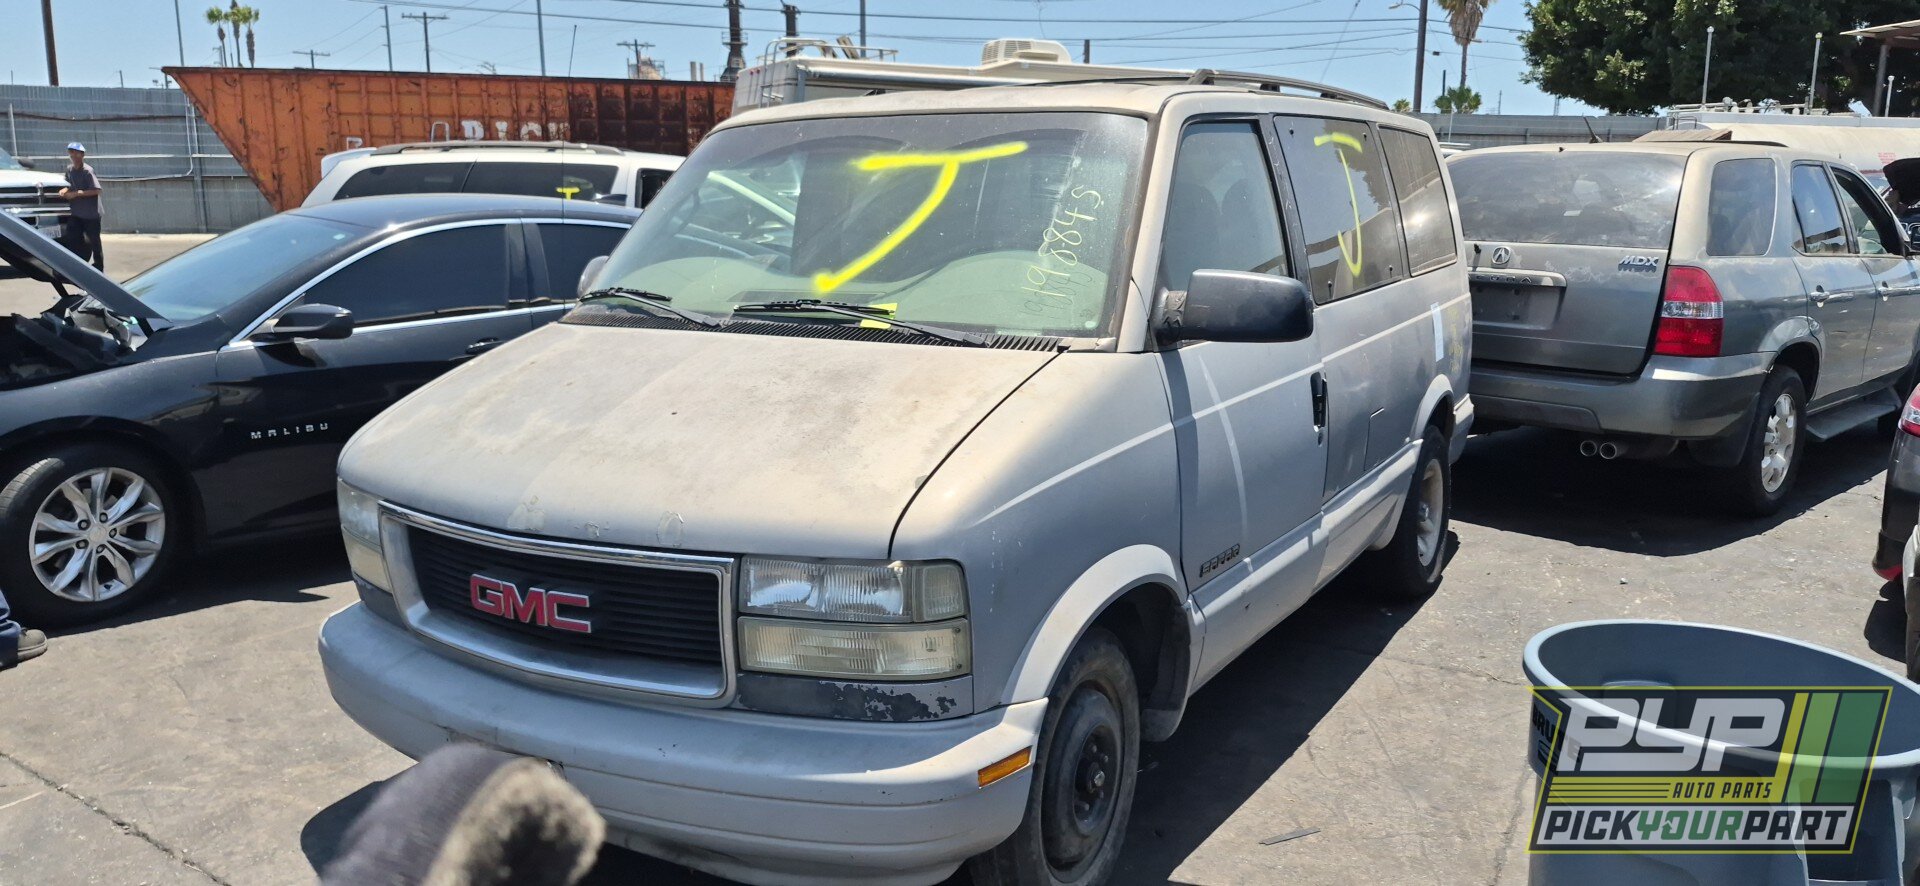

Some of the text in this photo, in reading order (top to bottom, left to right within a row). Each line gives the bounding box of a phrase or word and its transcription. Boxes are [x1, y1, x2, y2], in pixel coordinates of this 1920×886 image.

[1618, 255, 1659, 267] MDX
[1468, 274, 1532, 284] CURA
[250, 422, 328, 439] MALIBU
[470, 573, 592, 634] GMC
